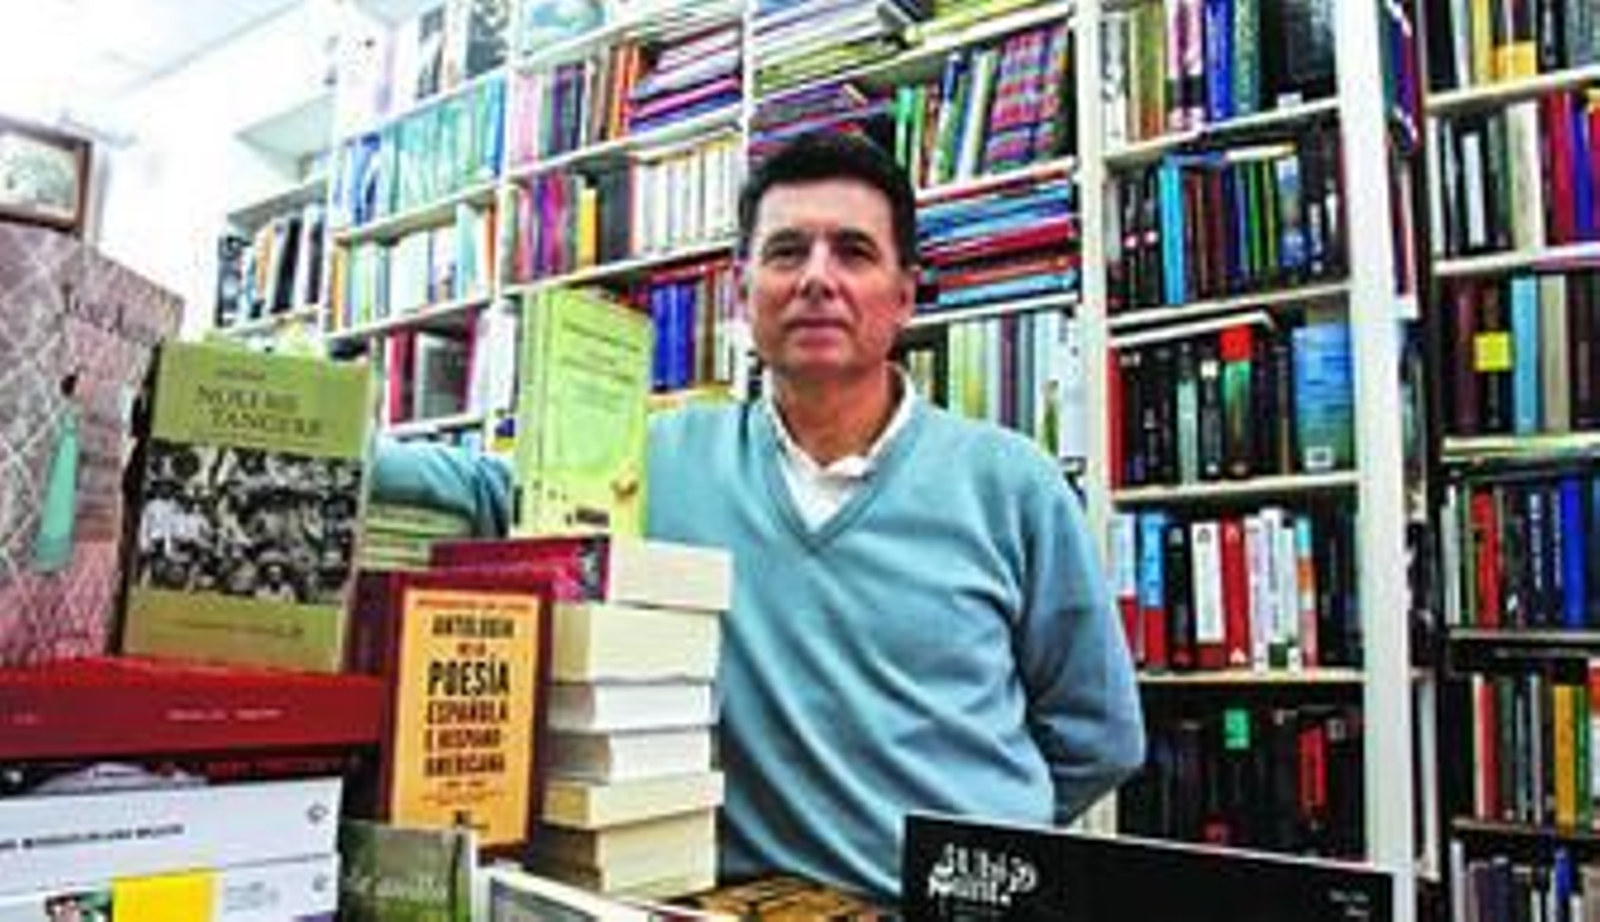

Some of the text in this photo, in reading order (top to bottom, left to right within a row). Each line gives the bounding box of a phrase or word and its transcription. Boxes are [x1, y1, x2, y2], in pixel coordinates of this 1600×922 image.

[198, 385, 258, 410] NOLI
[210, 407, 323, 437] TANGERE
[427, 655, 510, 697] POESÍA
[426, 699, 509, 725] ESPAÑOLA
[424, 753, 506, 778] AMERICANA
